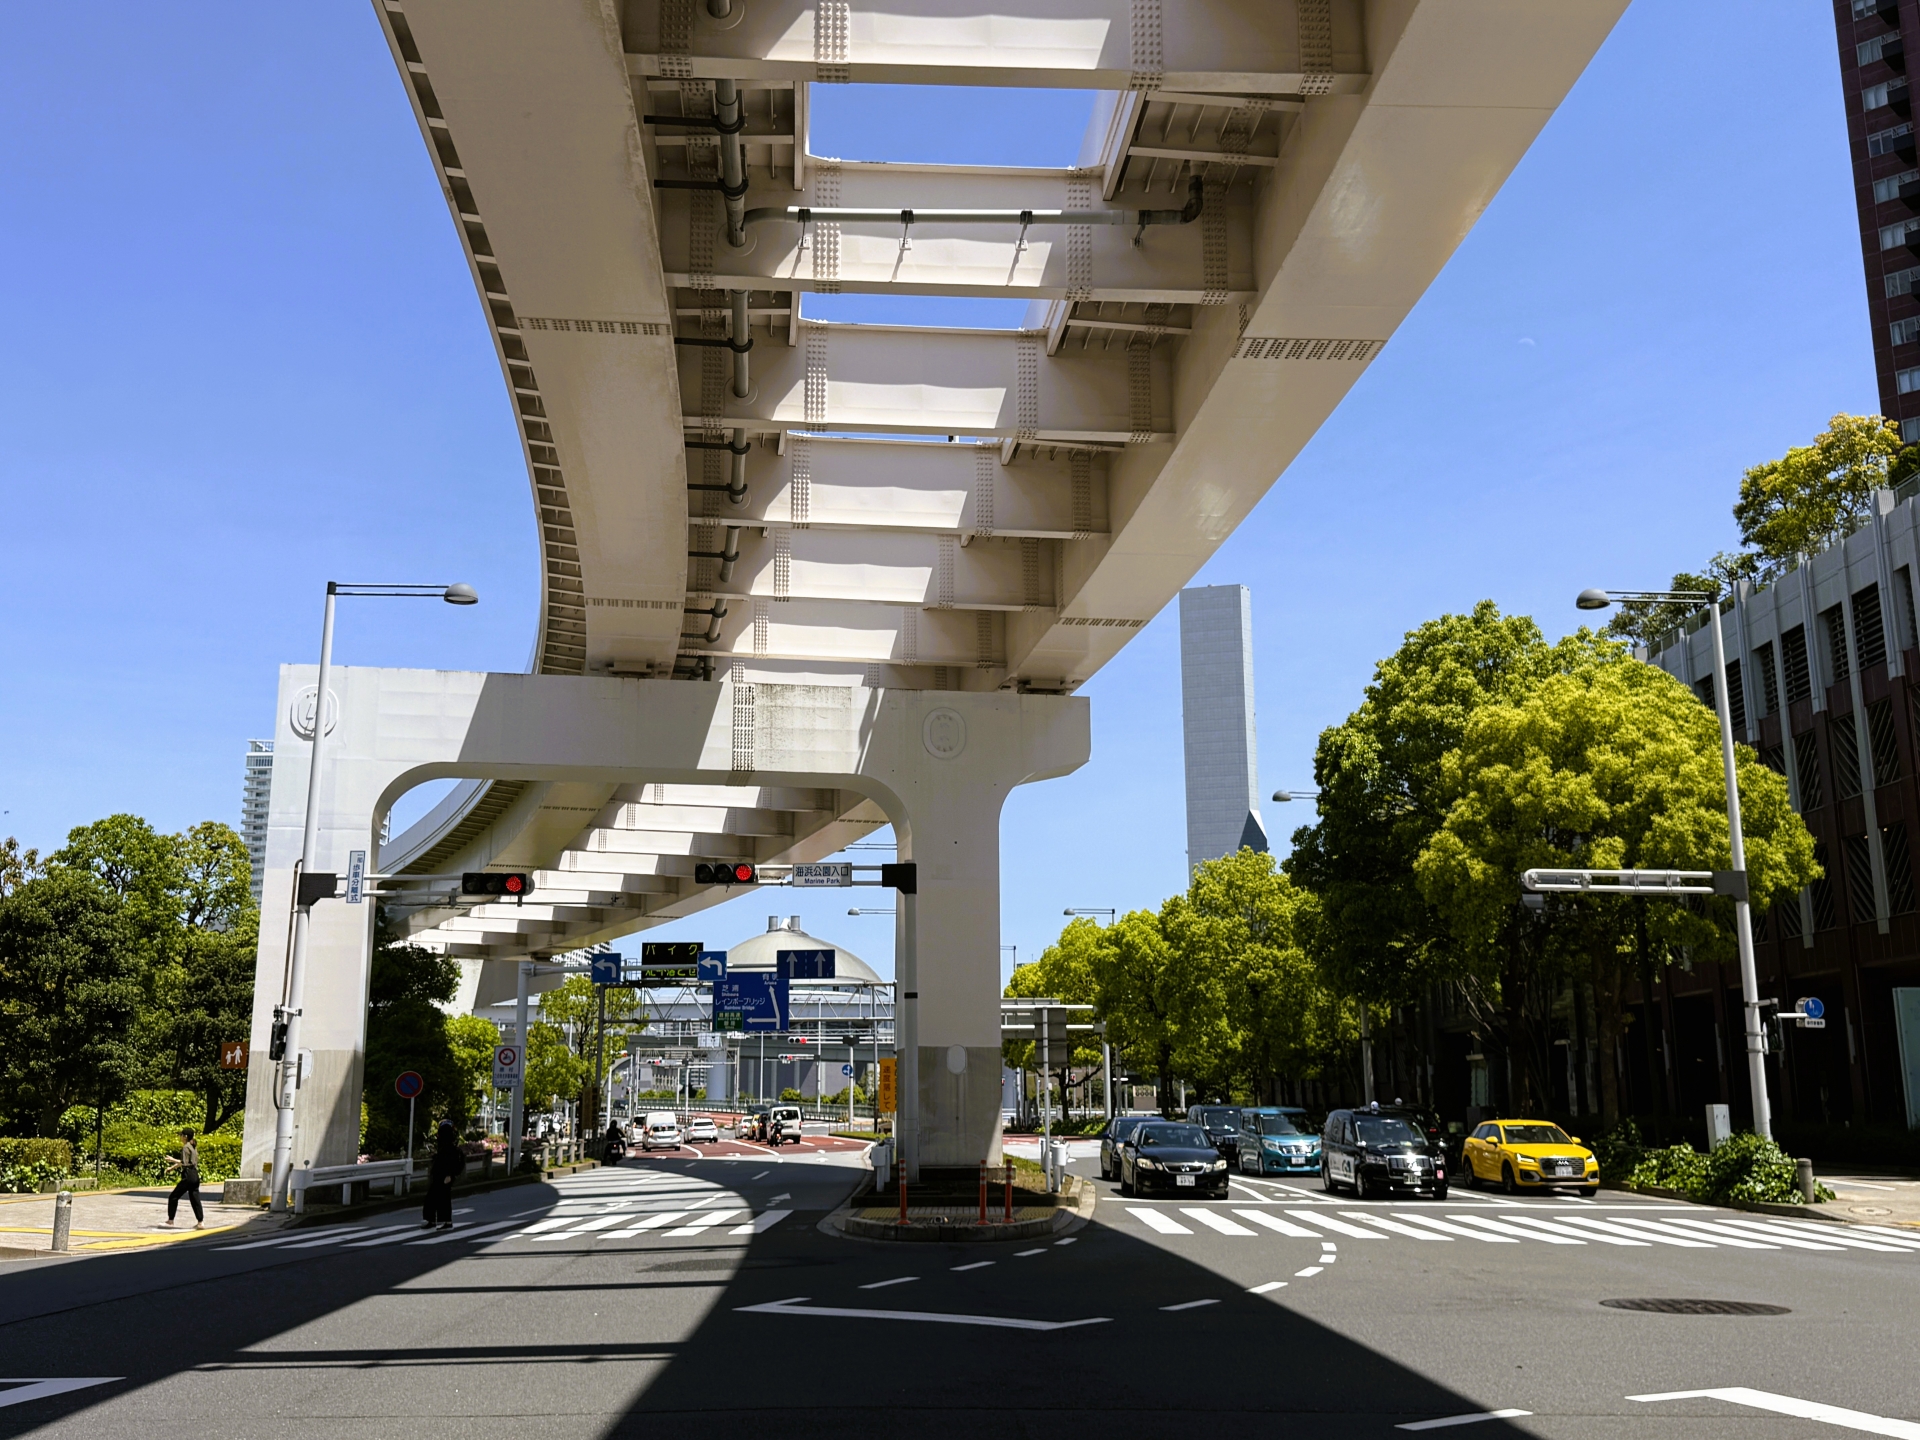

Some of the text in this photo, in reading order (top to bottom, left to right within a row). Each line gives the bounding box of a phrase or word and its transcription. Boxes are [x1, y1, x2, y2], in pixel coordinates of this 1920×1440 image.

[796, 866, 848, 877] 海浜公園入口
[646, 945, 697, 955] バイク
[715, 997, 766, 1006] レインボーブリッジ
